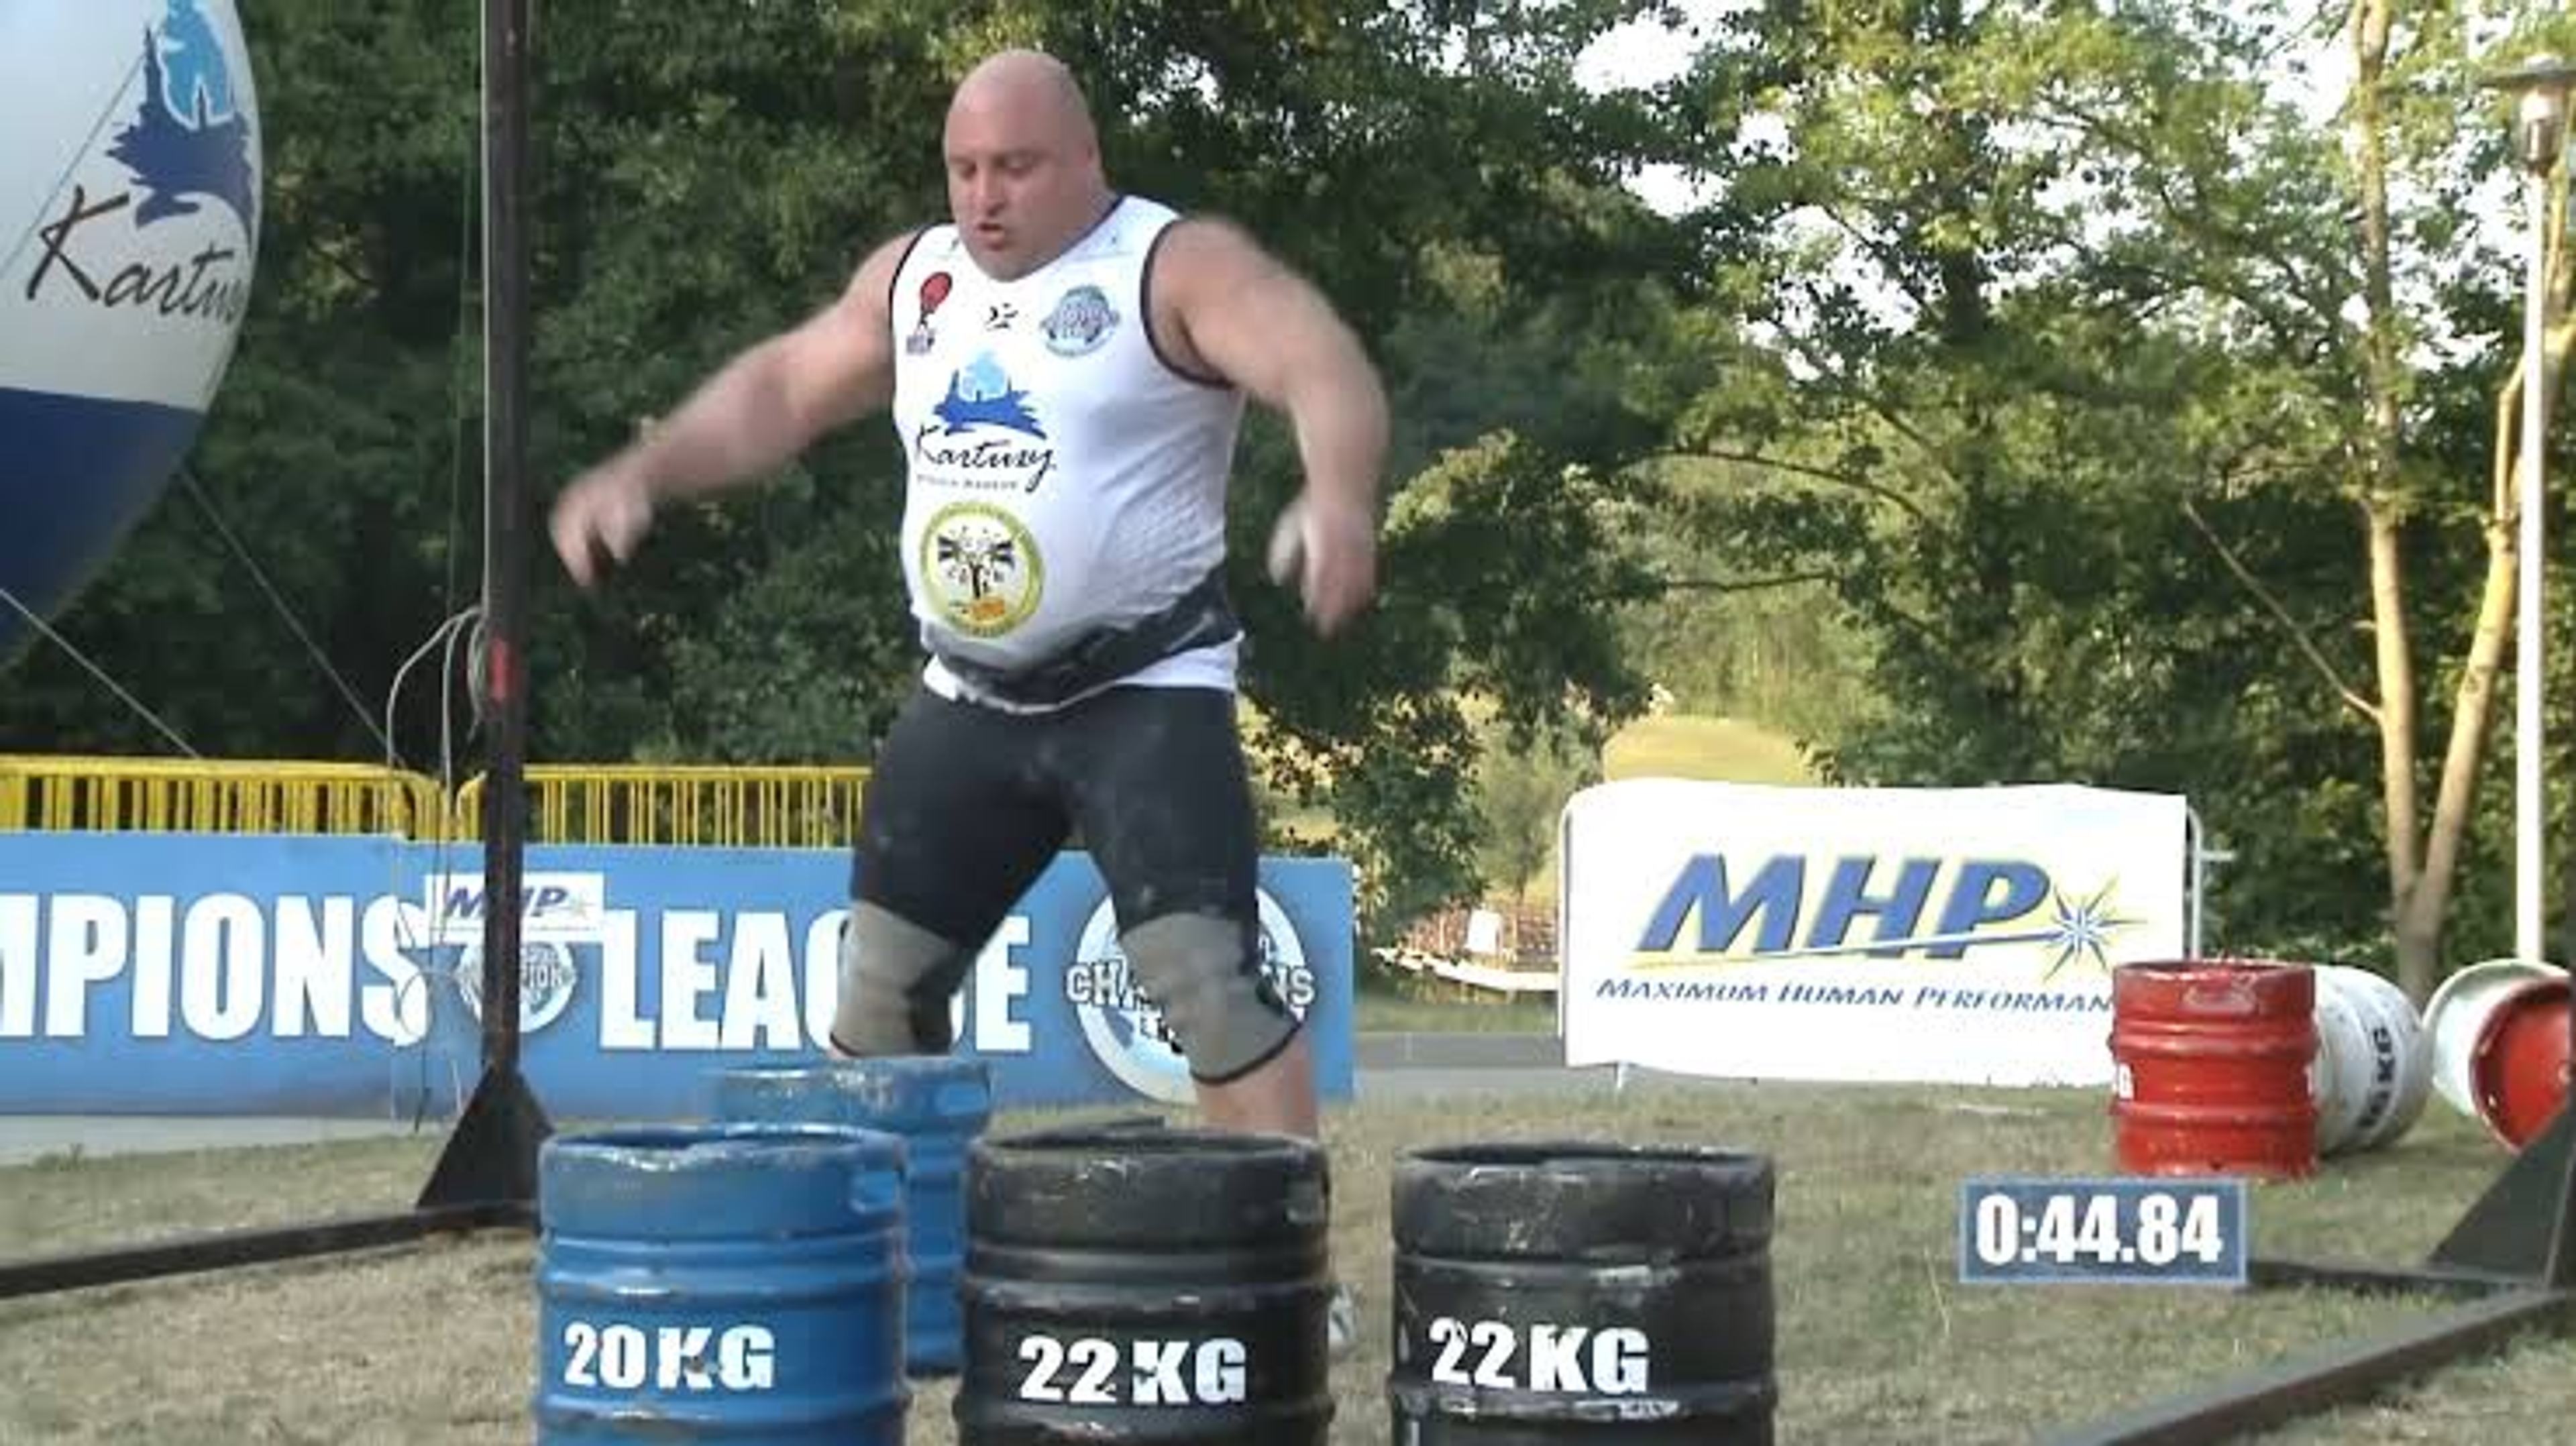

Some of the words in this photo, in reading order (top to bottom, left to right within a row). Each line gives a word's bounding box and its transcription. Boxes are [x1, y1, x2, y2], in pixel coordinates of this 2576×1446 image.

[915, 425, 1057, 494] Kartuzy
[442, 887, 569, 917] MP
[1635, 852, 2051, 959] MHP
[600, 909, 1031, 1052] LEAE
[1596, 978, 1768, 1001] MAXIMUM
[1777, 983, 1903, 1007] HUMAN
[564, 1322, 646, 1389] 20
[658, 1325, 775, 1391] KG
[1018, 1336, 1118, 1403] 22
[1132, 1339, 1246, 1404] KG
[1429, 1317, 1515, 1389] 22
[1530, 1323, 1649, 1394] KG
